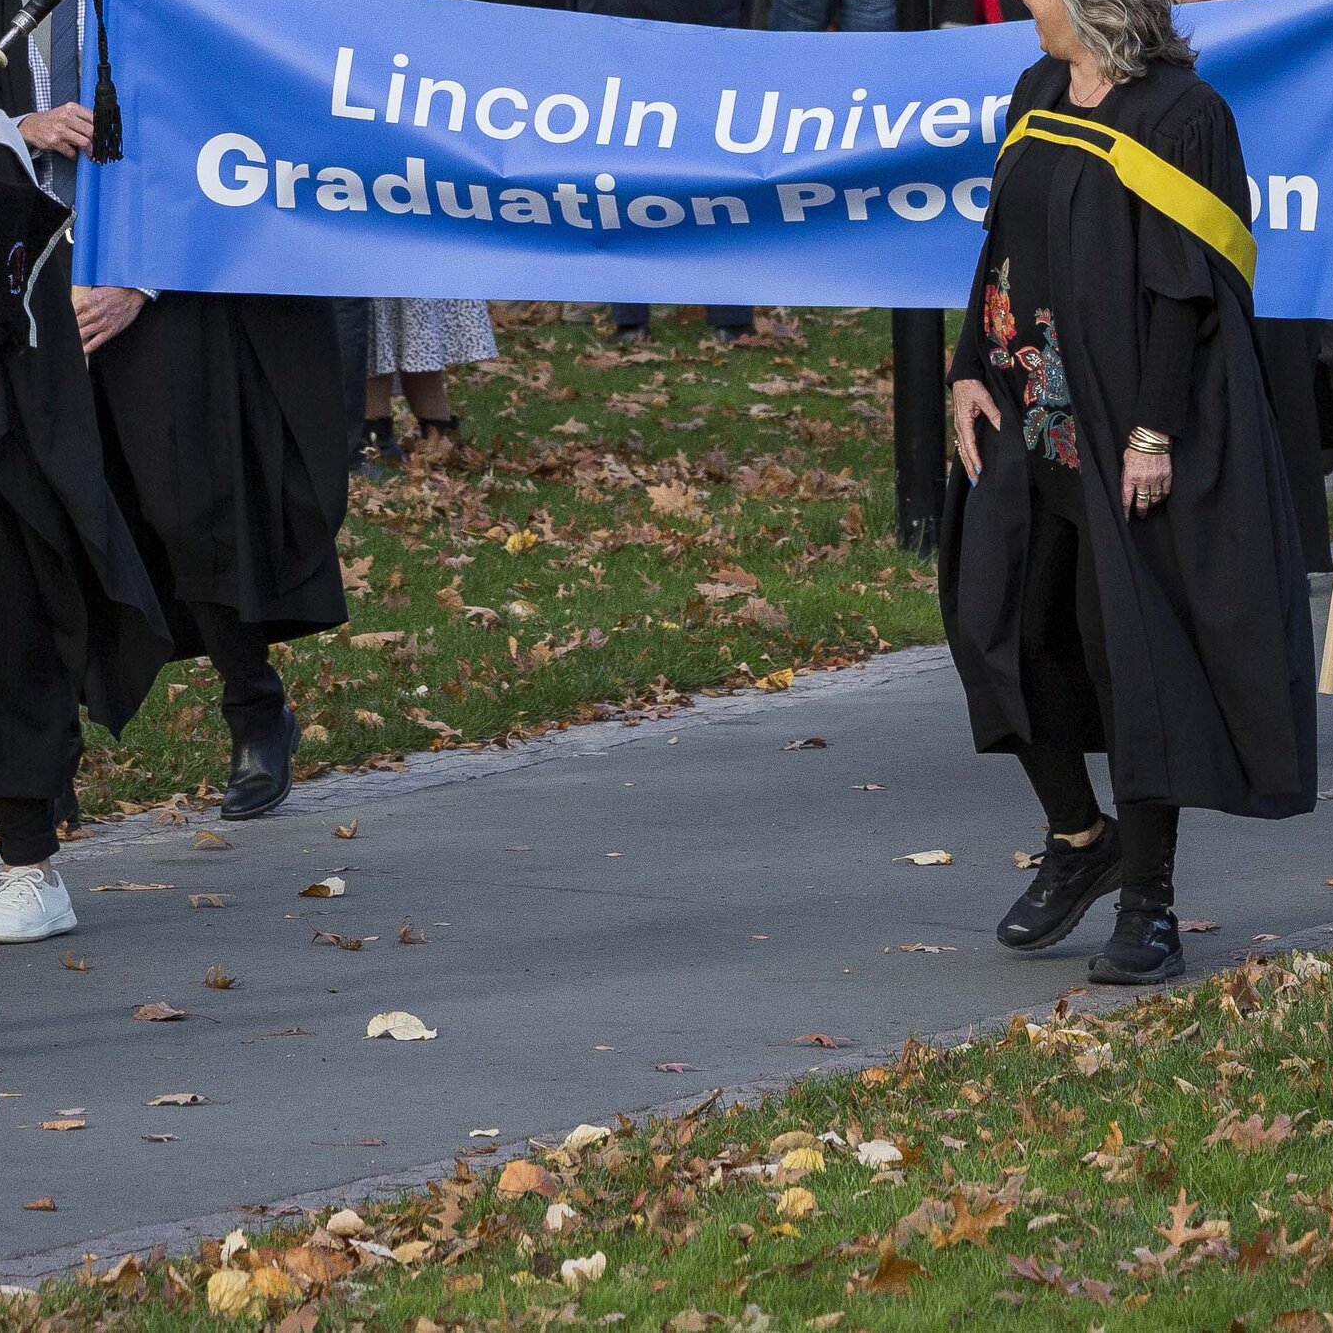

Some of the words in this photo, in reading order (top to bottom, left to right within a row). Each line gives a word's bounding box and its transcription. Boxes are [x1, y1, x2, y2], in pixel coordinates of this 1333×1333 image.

[330, 46, 679, 149] Lincoln
[714, 88, 1013, 154] Univer
[196, 132, 749, 230] Graduation
